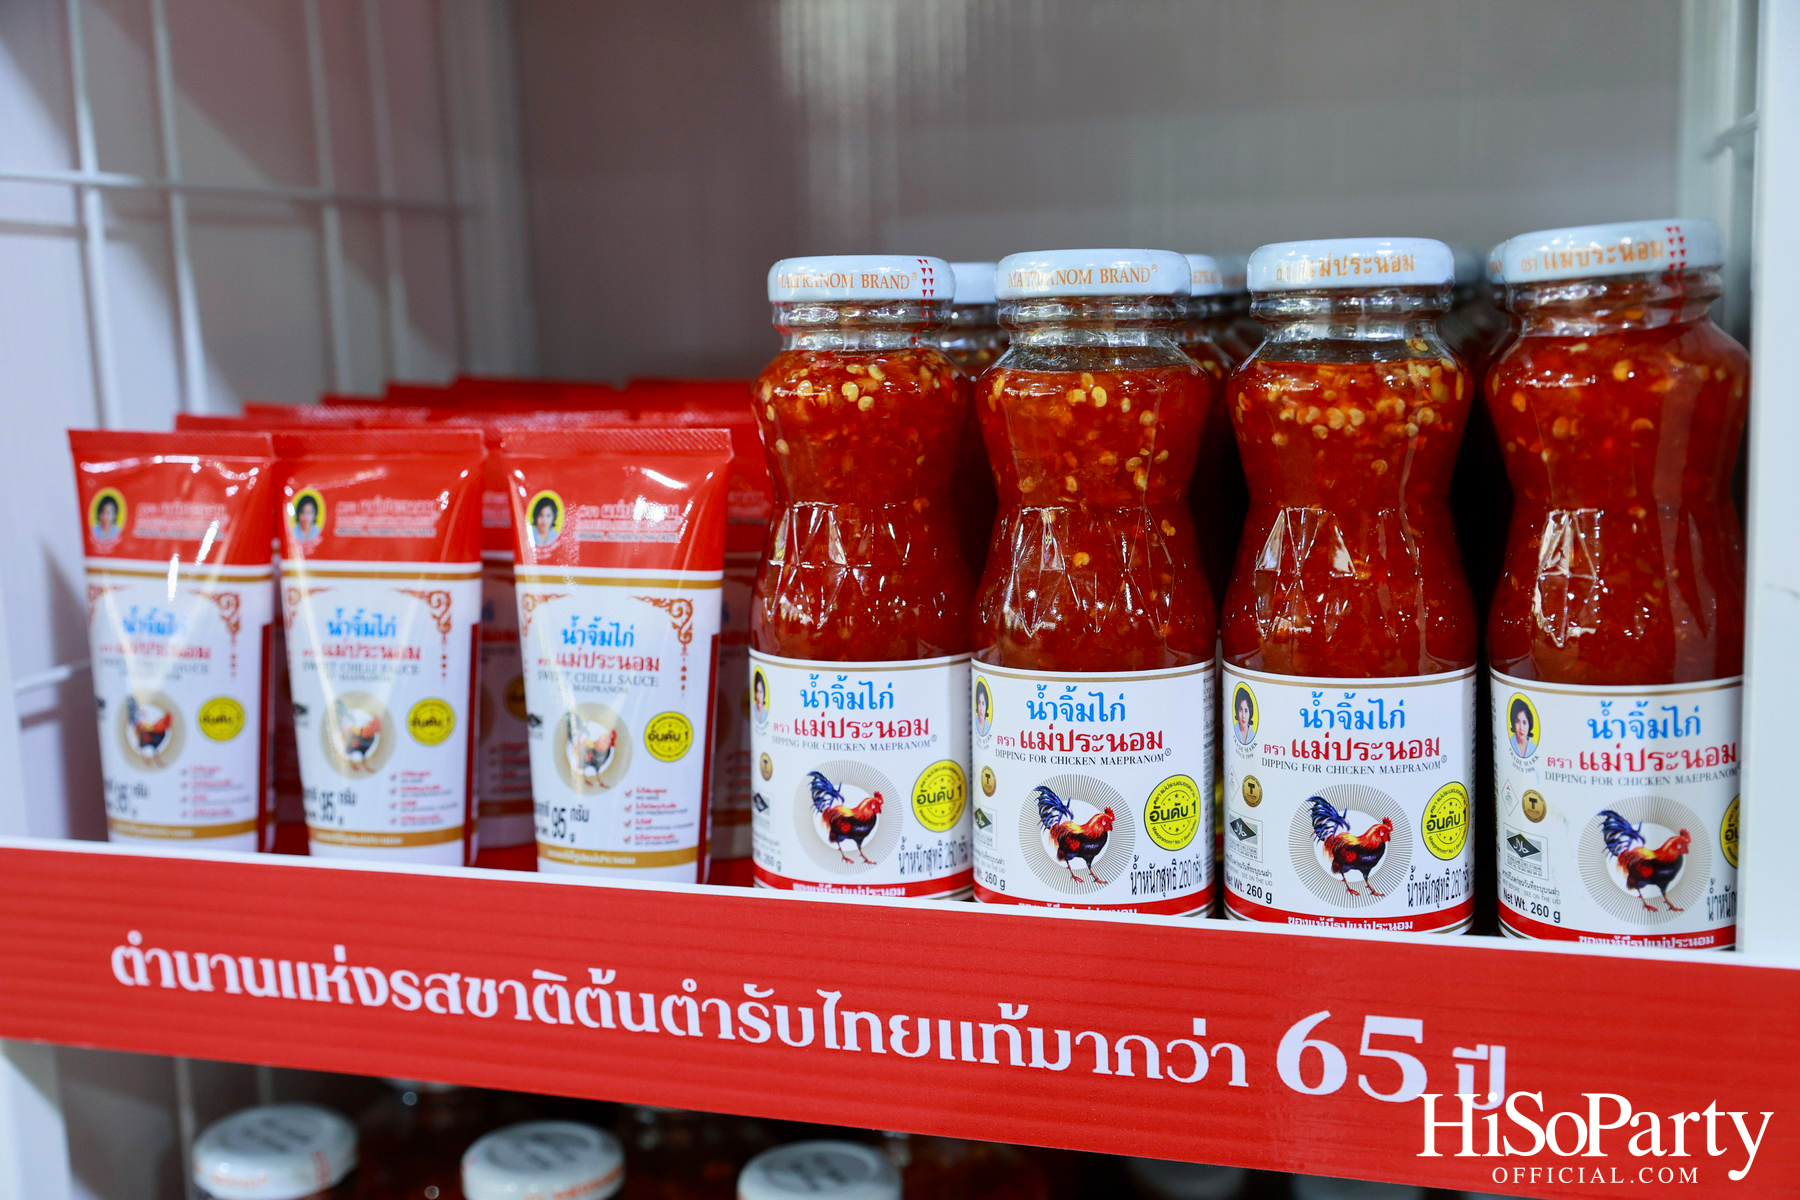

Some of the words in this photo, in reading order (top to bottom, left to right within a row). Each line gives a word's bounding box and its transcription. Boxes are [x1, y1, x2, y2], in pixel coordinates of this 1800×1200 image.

[861, 273, 910, 290] BRAND
[1100, 267, 1151, 284] BRAND
[561, 615, 635, 647] น้ำจิ้มไก่
[574, 673, 612, 685] CHILLI
[618, 674, 659, 687] SAUCE
[800, 673, 894, 710] น้ำจิ้มไก่
[1026, 683, 1126, 722] น้ำจิ้มไก่
[1299, 691, 1406, 730] น้ำจิ้มไก่
[794, 712, 929, 739] แม่ประนอม
[1587, 700, 1702, 740] น้ำจิ้มไก่
[802, 740, 819, 751] FOR
[822, 742, 866, 752] CHICKEN
[997, 735, 1016, 748] ตรา
[1020, 723, 1163, 753] แม่ประนอม
[1264, 743, 1286, 756] ตรา
[1292, 732, 1440, 761] แม่ประนอม
[995, 748, 1026, 762] DIPPING
[1029, 753, 1047, 764] FOR
[1050, 755, 1096, 766] CHICKEN
[1100, 753, 1164, 766] MAEPRANOM
[1261, 757, 1298, 772] DIPPING
[1301, 763, 1322, 774] FOR
[1326, 765, 1375, 775] CHICKEN
[1379, 761, 1441, 775] MAEPRANOM
[1547, 756, 1572, 770] ตรา
[1579, 742, 1737, 773] แม่ประนอม
[1545, 771, 1587, 785] DIPPING
[1591, 775, 1613, 787] FOR
[1617, 775, 1671, 787] CHICKEN
[1675, 766, 1738, 785] MAEPRANOM
[916, 786, 954, 805] อันดับ
[1149, 802, 1189, 822] อันดับ
[1191, 800, 1197, 815] 1
[1426, 810, 1461, 832] อันดับ
[985, 871, 998, 886] 260
[999, 879, 1006, 891] g
[1130, 854, 1177, 898] น้ำหนักสุทธิ
[1179, 859, 1192, 889] 260
[1407, 865, 1450, 909] น้ำหนักสุทธิ
[1246, 883, 1263, 899] 260
[1265, 891, 1273, 905] g
[1503, 887, 1513, 905] Net
[1514, 894, 1528, 912] Wt.
[1530, 901, 1549, 918] 260
[1553, 910, 1561, 923] g
[111, 929, 1249, 1088] ตำนานแห่งรสชาติต้นตำรับไทยแท้มากว่า
[1276, 1010, 1428, 1103] 65
[1452, 1043, 1507, 1111] ปี
